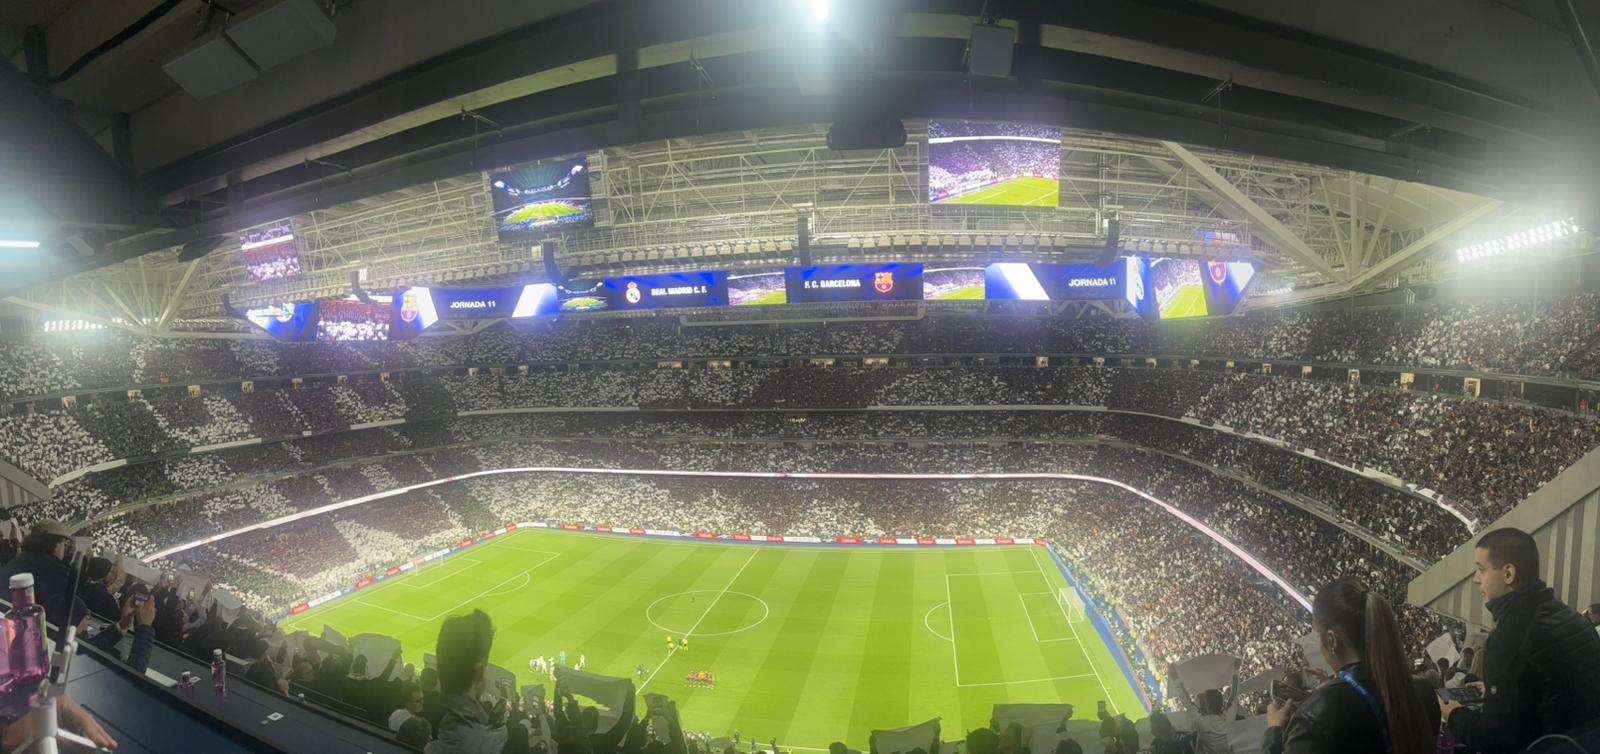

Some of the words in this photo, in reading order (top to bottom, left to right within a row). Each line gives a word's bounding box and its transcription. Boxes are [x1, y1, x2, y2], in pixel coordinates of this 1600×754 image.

[820, 279, 860, 288] BARCELONA
[1068, 278, 1108, 287] JORNADA
[450, 300, 486, 308] JORNADA
